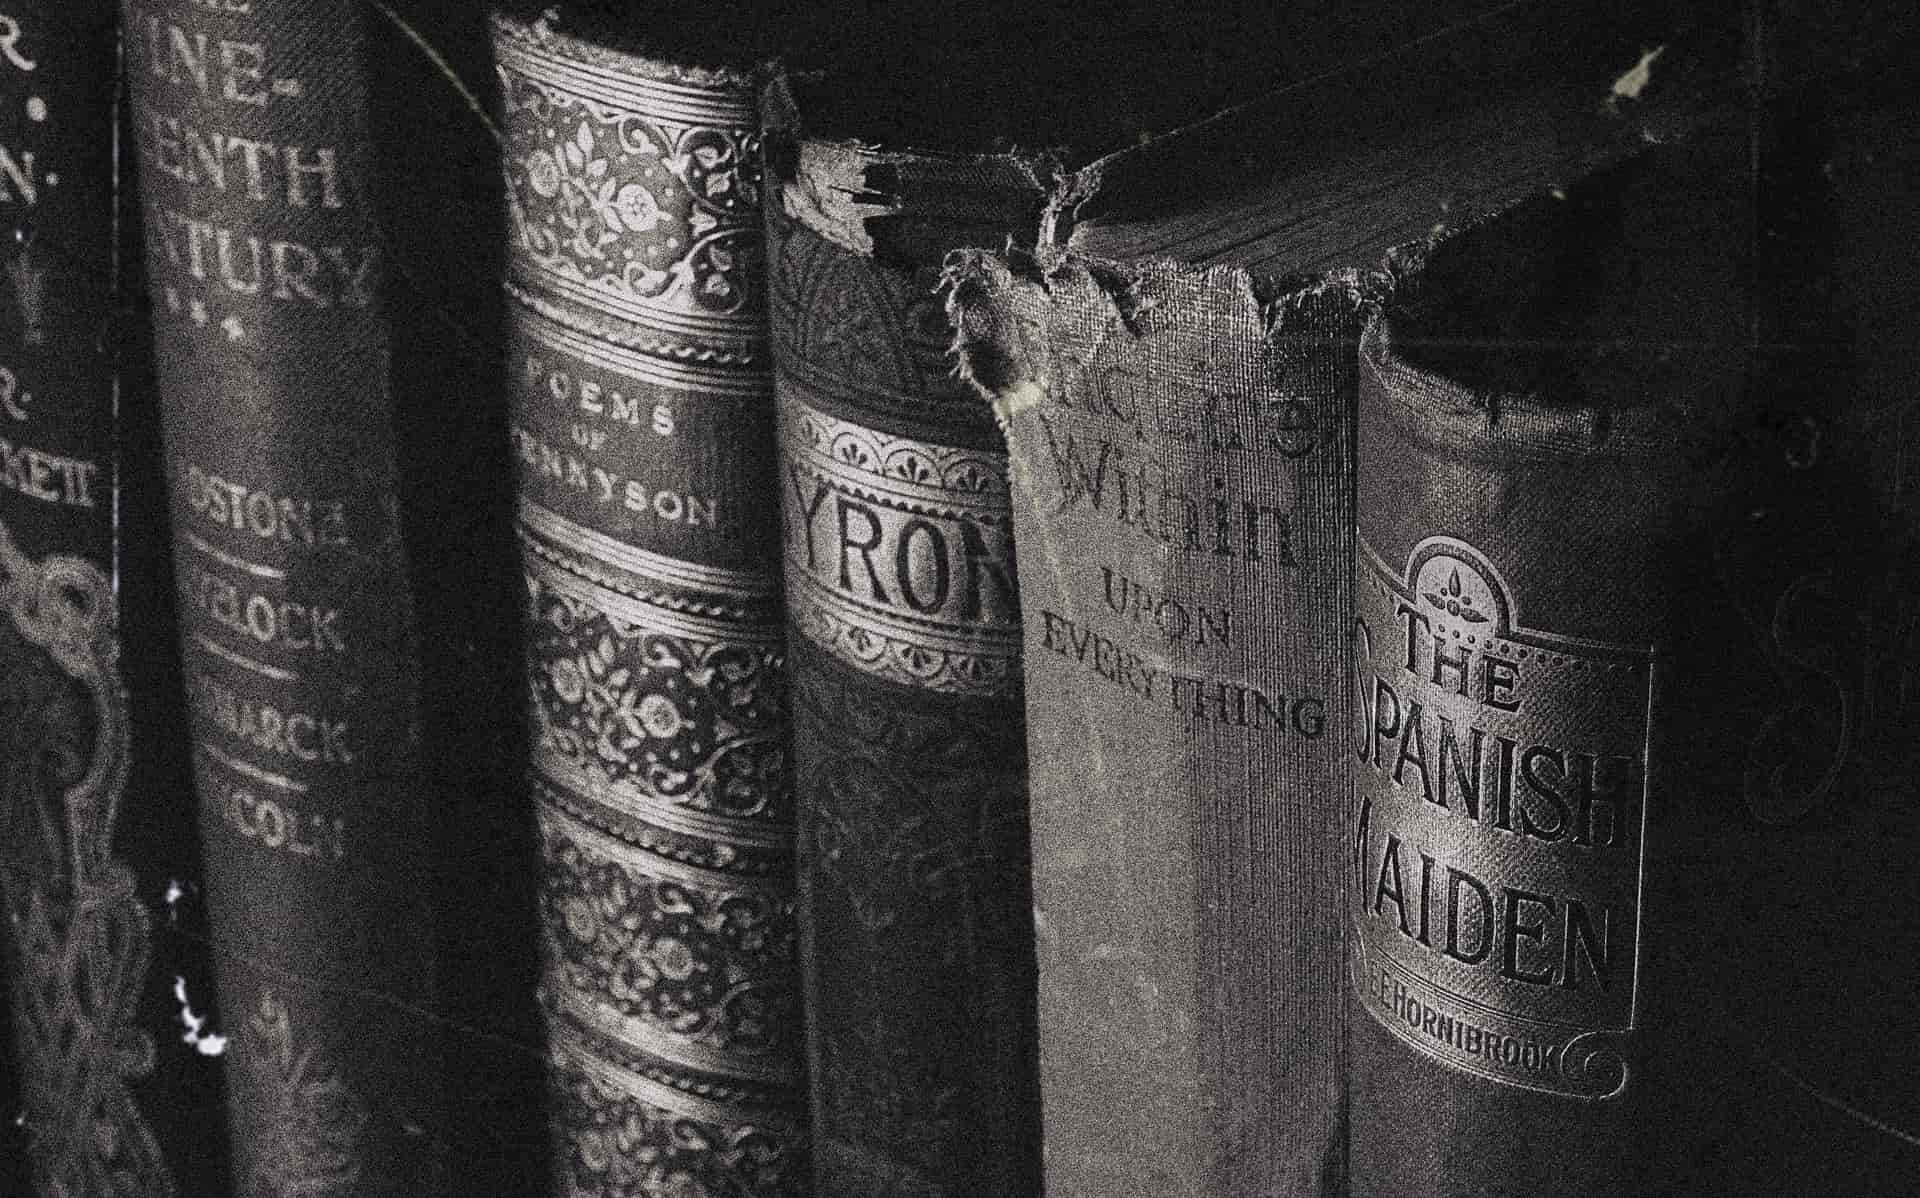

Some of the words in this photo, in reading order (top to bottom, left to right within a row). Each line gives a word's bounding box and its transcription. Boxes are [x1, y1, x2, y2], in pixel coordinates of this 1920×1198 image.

[526, 356, 676, 436] POEMS
[571, 423, 606, 451] OF
[1100, 566, 1232, 650] UPON
[1397, 605, 1522, 713] THE
[1354, 616, 1633, 848] SPANISH
